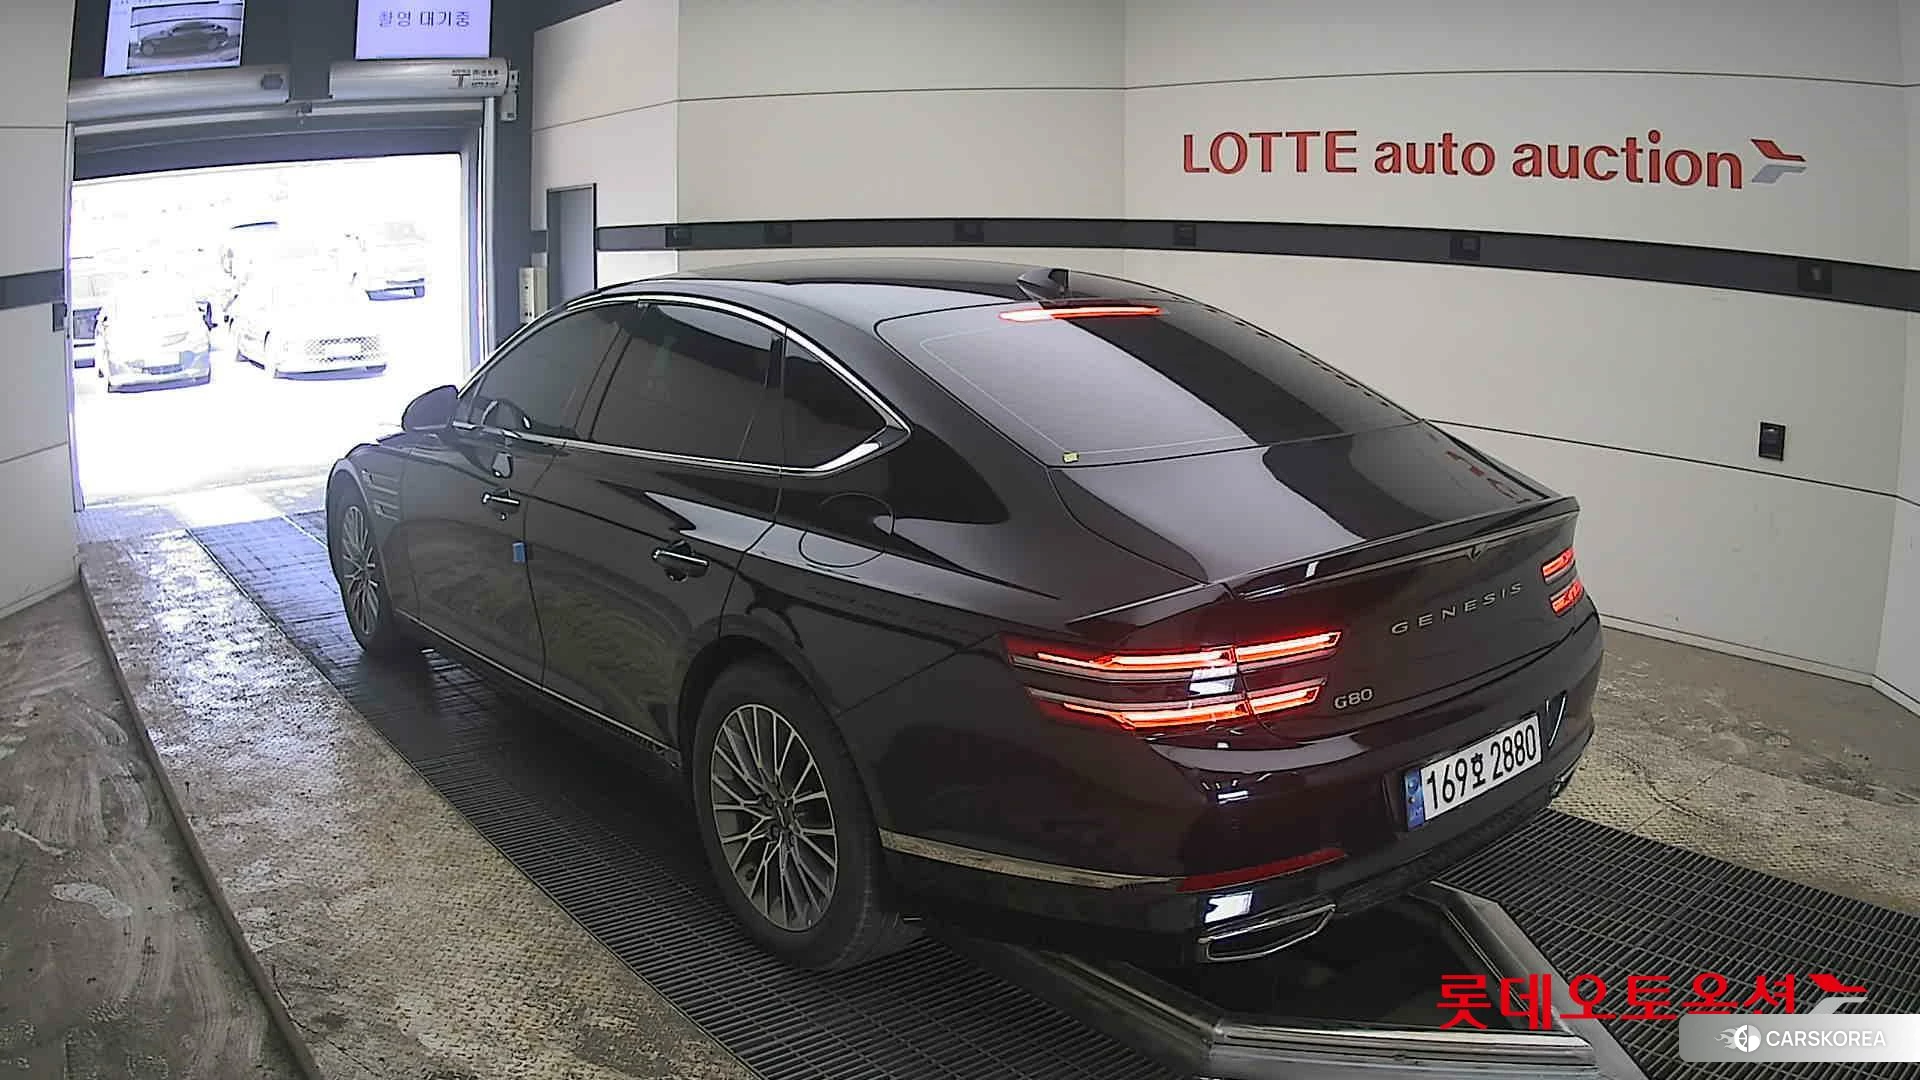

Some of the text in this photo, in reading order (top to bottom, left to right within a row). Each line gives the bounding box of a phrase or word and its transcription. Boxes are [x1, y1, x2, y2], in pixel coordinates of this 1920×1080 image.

[420, 11, 470, 27] 대기중
[1183, 130, 1744, 189] LOTTE auto auction
[1391, 582, 1522, 635] GENESIS
[1334, 687, 1374, 710] G80
[1426, 724, 1538, 810] 169호 2880
